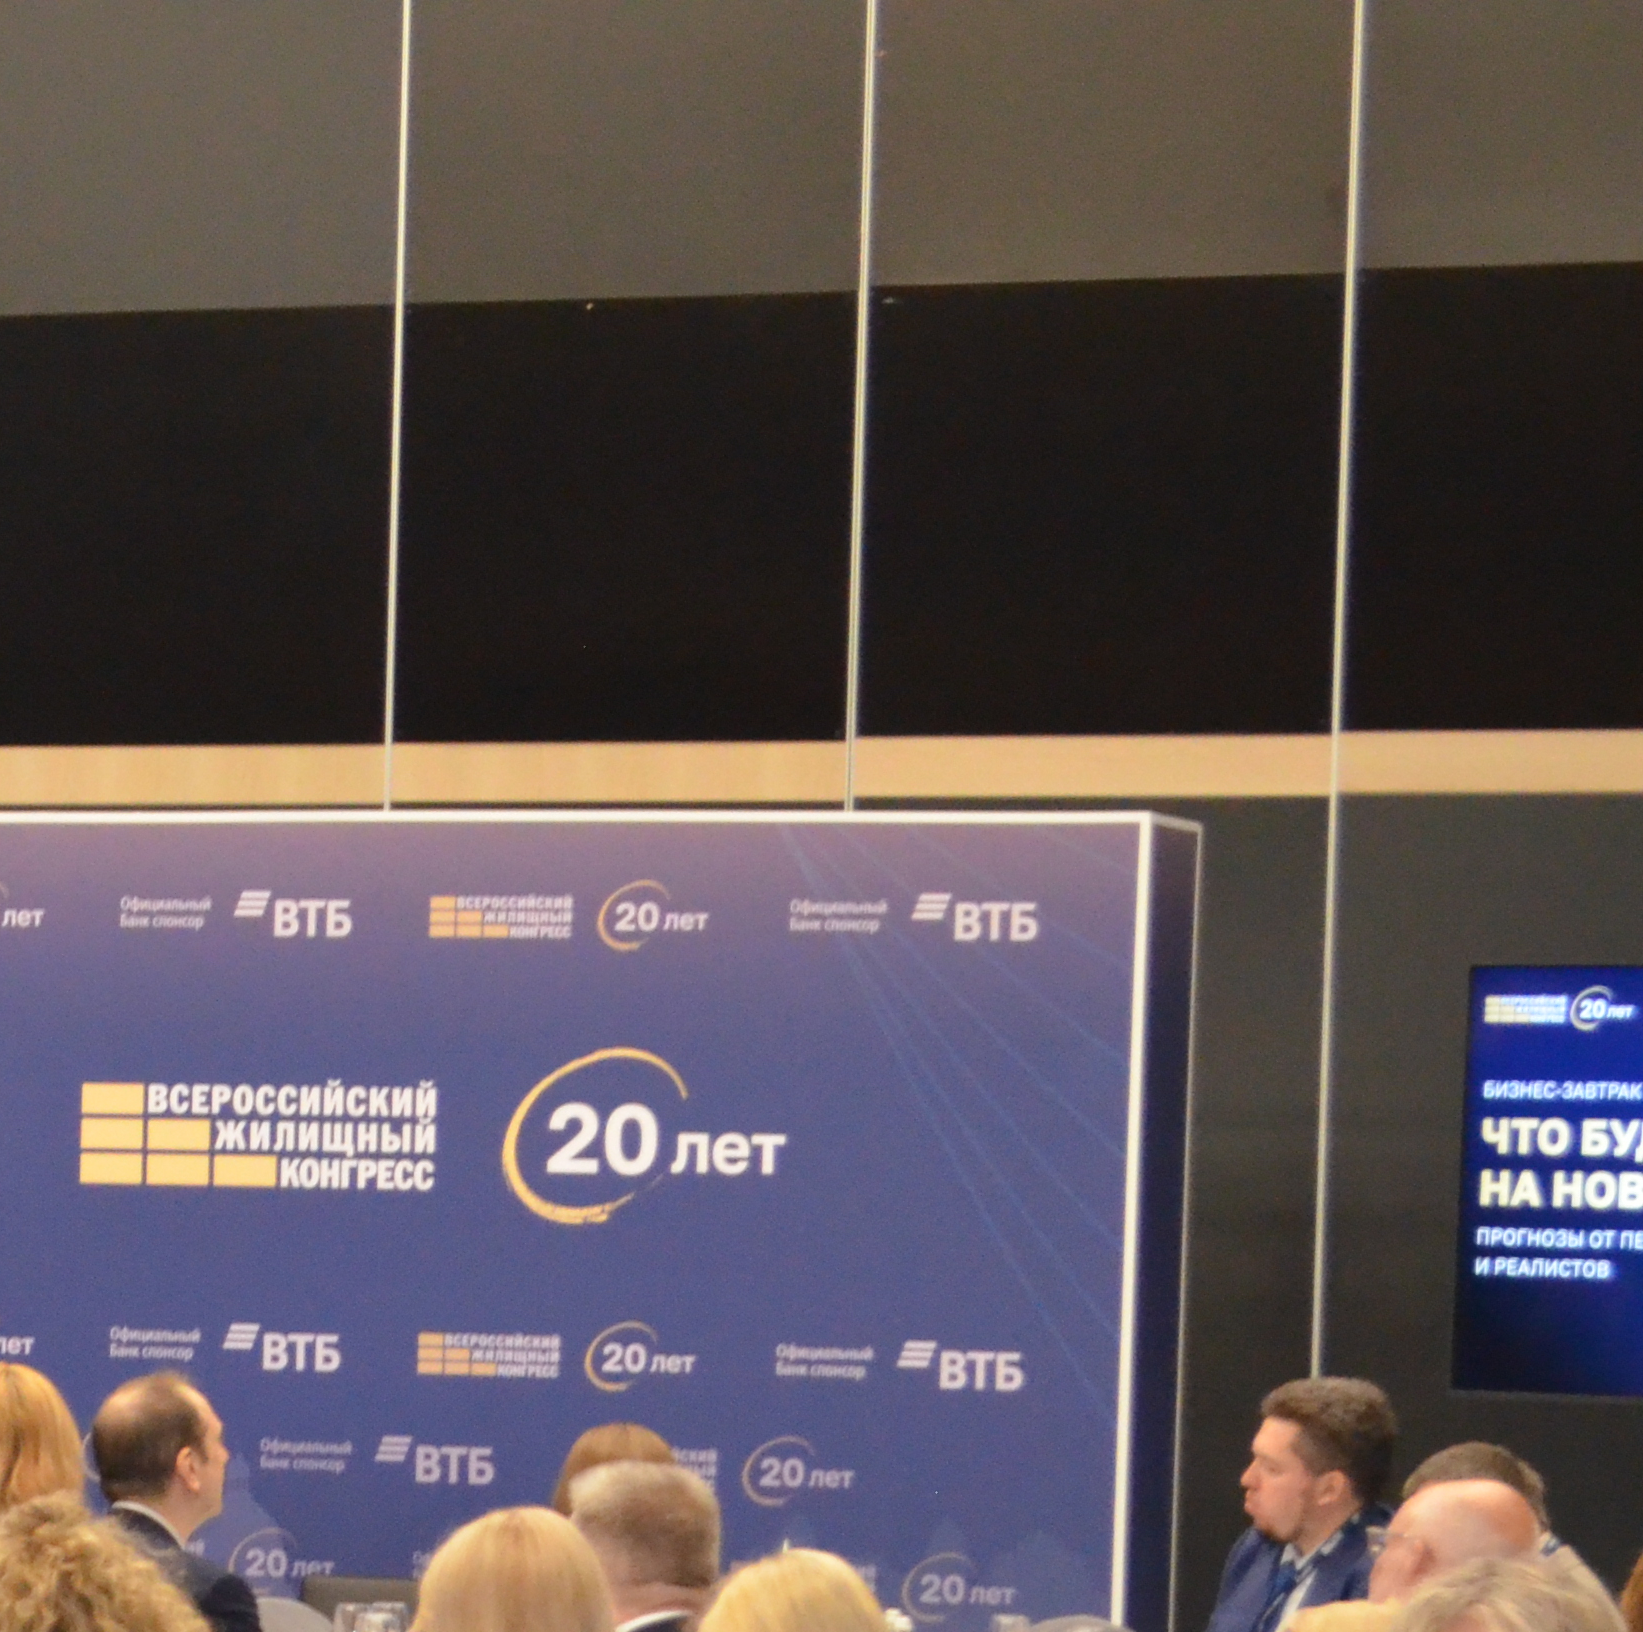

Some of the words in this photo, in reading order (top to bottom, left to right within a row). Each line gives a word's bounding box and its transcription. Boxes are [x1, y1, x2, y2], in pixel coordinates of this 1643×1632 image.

[120, 894, 212, 914] Официальный
[789, 898, 888, 917] Официальный
[2, 906, 44, 929] лет
[120, 914, 151, 929] Банк
[153, 916, 205, 931] спонсор
[273, 899, 353, 938] ВТБ
[615, 902, 659, 931] 20
[664, 909, 708, 932] лет
[789, 917, 824, 932] Банк
[825, 918, 879, 934] спонсор
[952, 901, 1038, 943] ВТБ
[510, 925, 571, 938] КОНГРЕСС
[1580, 1000, 1606, 1020] 20
[147, 1079, 437, 1117] ВСЕРОССИЙСКИЙ
[1483, 1080, 1642, 1100] БИЗНЕС-ЗАВТРАК
[215, 1117, 436, 1156] ЖИЛИЩНЫЙ
[546, 1102, 659, 1176] 20
[671, 1131, 786, 1175] лет
[1481, 1116, 1570, 1157] ЧТО
[279, 1157, 434, 1190] КОНГРЕСС
[1479, 1170, 1543, 1208] НА
[1476, 1227, 1585, 1248] ПРОГНОЗЫ
[1588, 1229, 1615, 1249] ОТ
[1474, 1258, 1490, 1277] И
[1493, 1257, 1612, 1280] РЕАЛИСТОВ
[109, 1326, 201, 1345] Официальный
[109, 1344, 141, 1359] Банк
[142, 1347, 194, 1361] спонсор
[262, 1333, 341, 1372] ВТБ
[602, 1343, 646, 1373] 20
[650, 1350, 696, 1375] лет
[776, 1342, 874, 1363] Официальный
[496, 1363, 559, 1378] КОНГРЕСС
[776, 1362, 809, 1377] Банк
[811, 1364, 866, 1381] спонсор
[938, 1350, 1023, 1391] ВТБ
[260, 1437, 352, 1457] Официальный
[260, 1456, 292, 1470] Банк
[293, 1458, 345, 1474] спонсор
[414, 1446, 494, 1485] ВТБ
[760, 1458, 804, 1488] 20
[809, 1466, 853, 1490] лет
[246, 1549, 287, 1577] 20
[921, 1574, 965, 1605] 20
[969, 1583, 1015, 1606] лет
